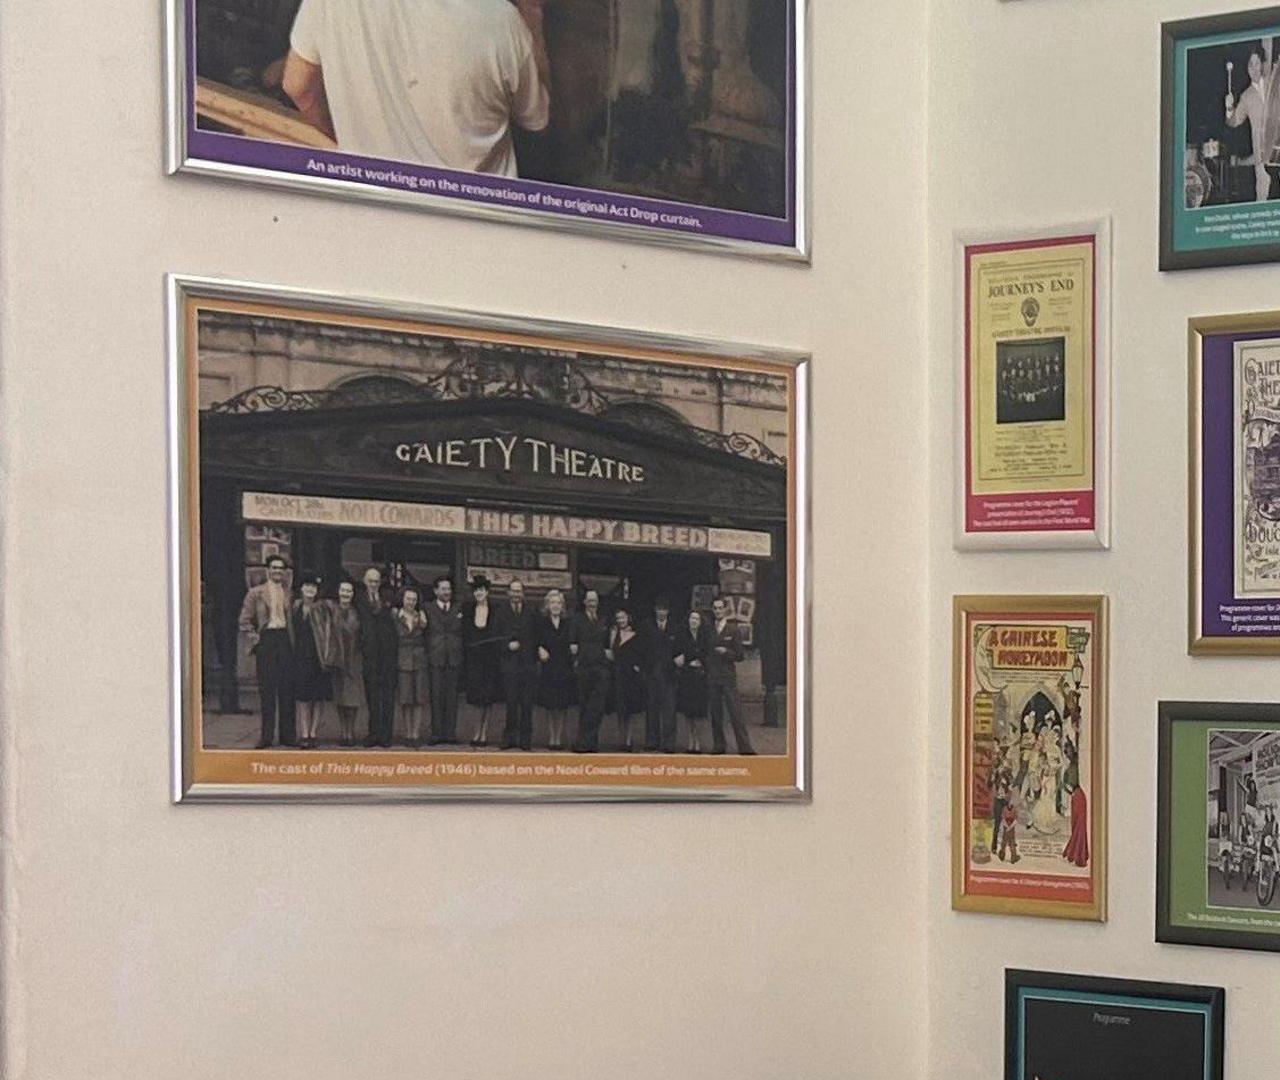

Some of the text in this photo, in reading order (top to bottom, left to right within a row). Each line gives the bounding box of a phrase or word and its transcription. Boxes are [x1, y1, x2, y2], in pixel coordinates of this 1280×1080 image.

[307, 159, 658, 222] An artist working on the renovation of the original Act Drop
[988, 281, 1045, 298] JOURNEY'S
[1050, 278, 1074, 292] END
[395, 436, 645, 483] GAIETY THEATRE
[466, 509, 709, 549] THIS HAPPY BREED
[1000, 629, 1058, 648] CHINESE
[998, 650, 1068, 667] HONEYMOON
[251, 762, 717, 777] The cast of This Happy Breed (1946) based on the Noel Coward of the same
